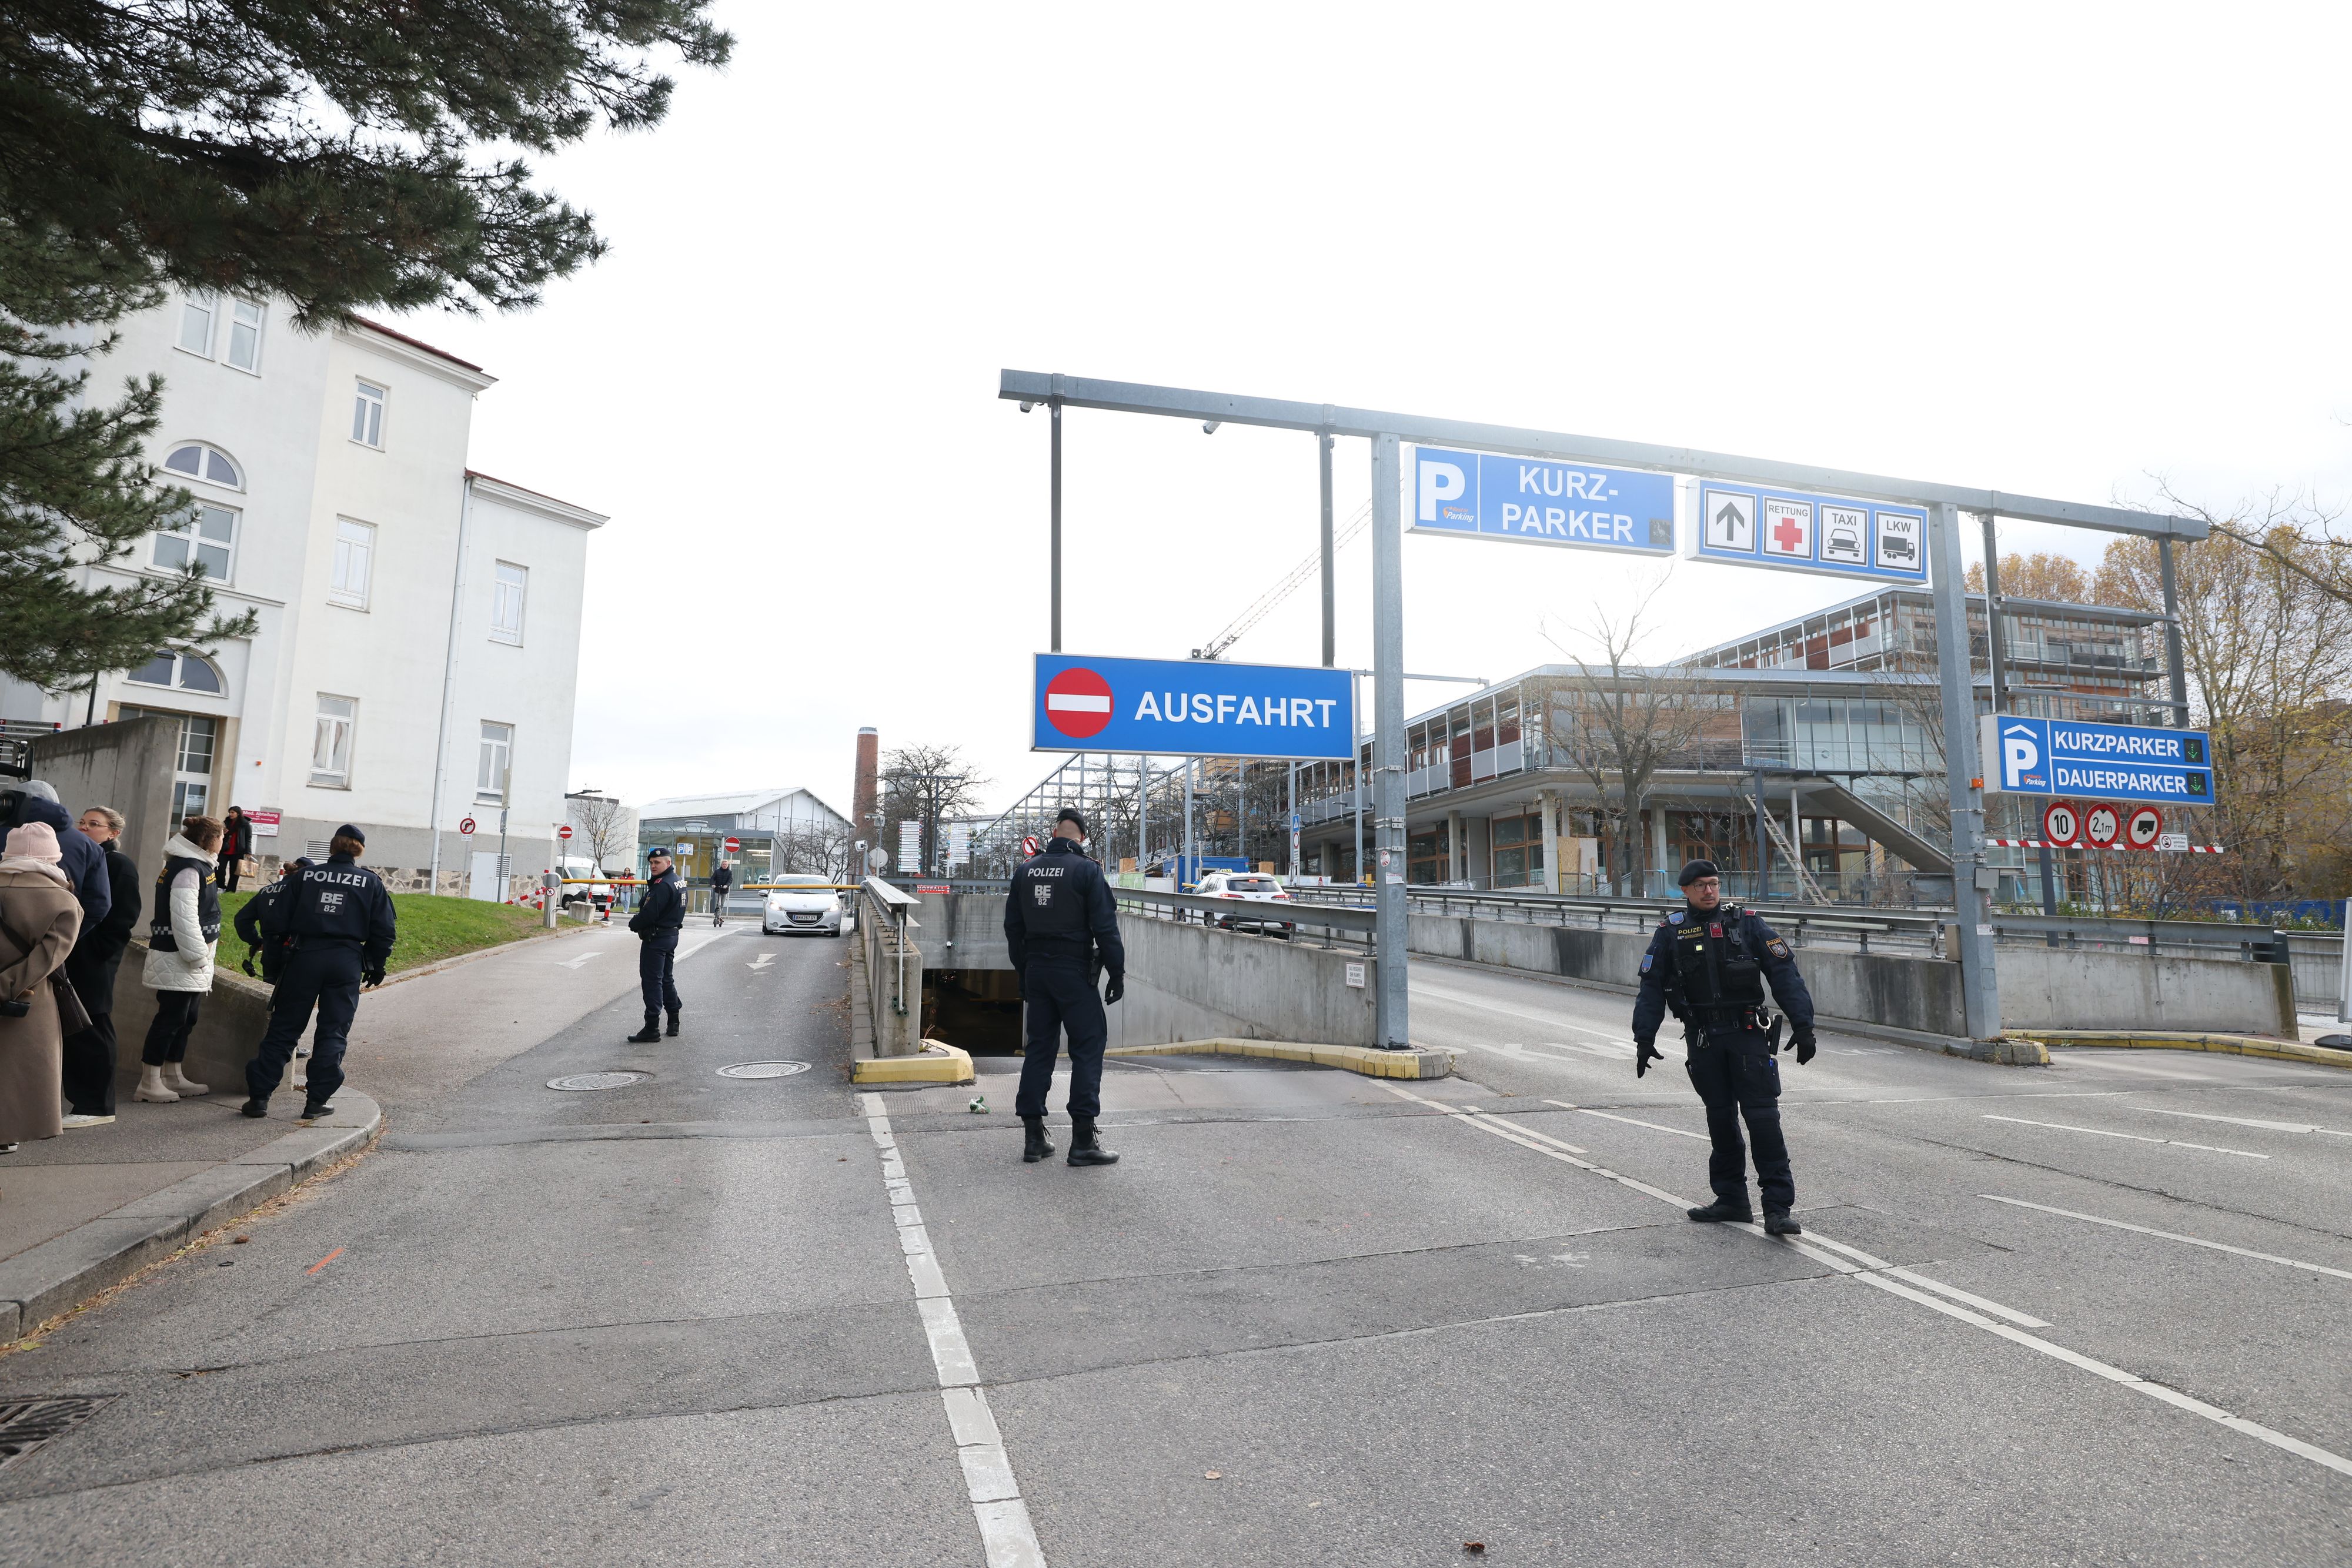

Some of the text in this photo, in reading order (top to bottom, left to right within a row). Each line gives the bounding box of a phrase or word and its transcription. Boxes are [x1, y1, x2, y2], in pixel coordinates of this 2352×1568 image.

[1419, 460, 1465, 521] P
[1519, 466, 1618, 502] KURZ-
[1446, 511, 1474, 523] Parking
[1769, 504, 1808, 517] RETTUNG
[1502, 503, 1635, 542] PARKER
[1832, 513, 1857, 526] TAXI
[1886, 520, 1911, 533] LKW
[1134, 691, 1337, 727] AUSFAHRT
[2055, 731, 2180, 757] KURZPARKER
[2004, 738, 2038, 787] P
[2026, 778, 2046, 787] Parking
[2057, 768, 2188, 794] DAUERPARKER
[2054, 815, 2069, 835] 10
[303, 870, 367, 888] POLIZEI
[1028, 868, 1064, 877] POLIZEI
[320, 892, 344, 905] BE
[1035, 885, 1051, 897] BE
[1678, 926, 1702, 934] POLIZEI
